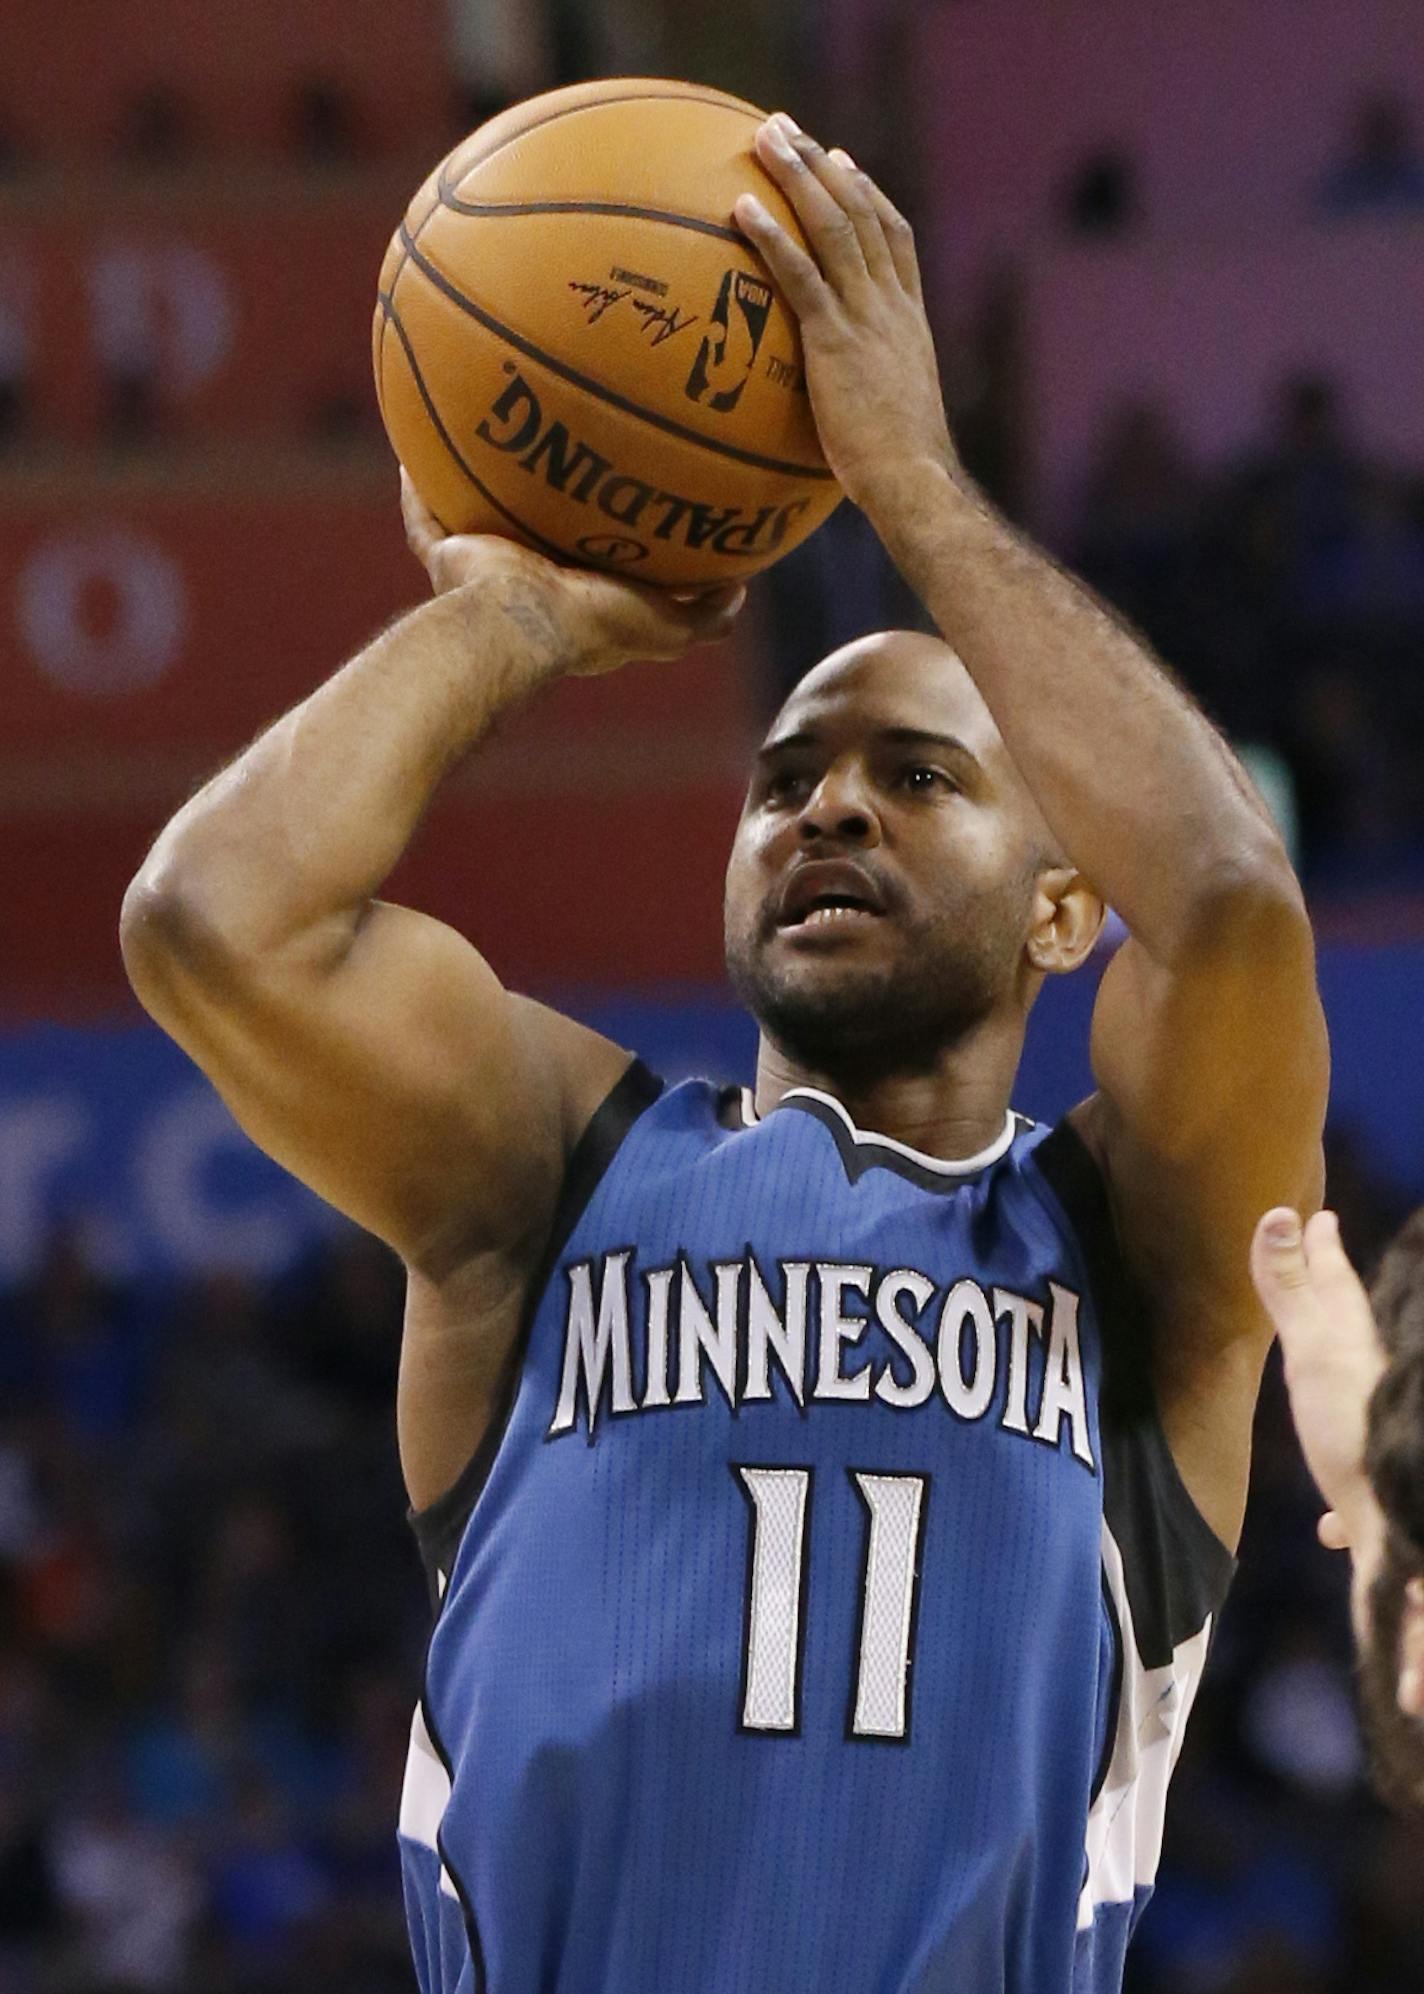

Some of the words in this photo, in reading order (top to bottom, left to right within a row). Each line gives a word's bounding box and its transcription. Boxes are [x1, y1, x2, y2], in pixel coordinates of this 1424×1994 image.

[736, 276, 770, 306] NBA
[474, 373, 811, 557] SPALDING
[546, 1246, 1096, 1476] MINNESOTA
[734, 1466, 927, 1740] 11
